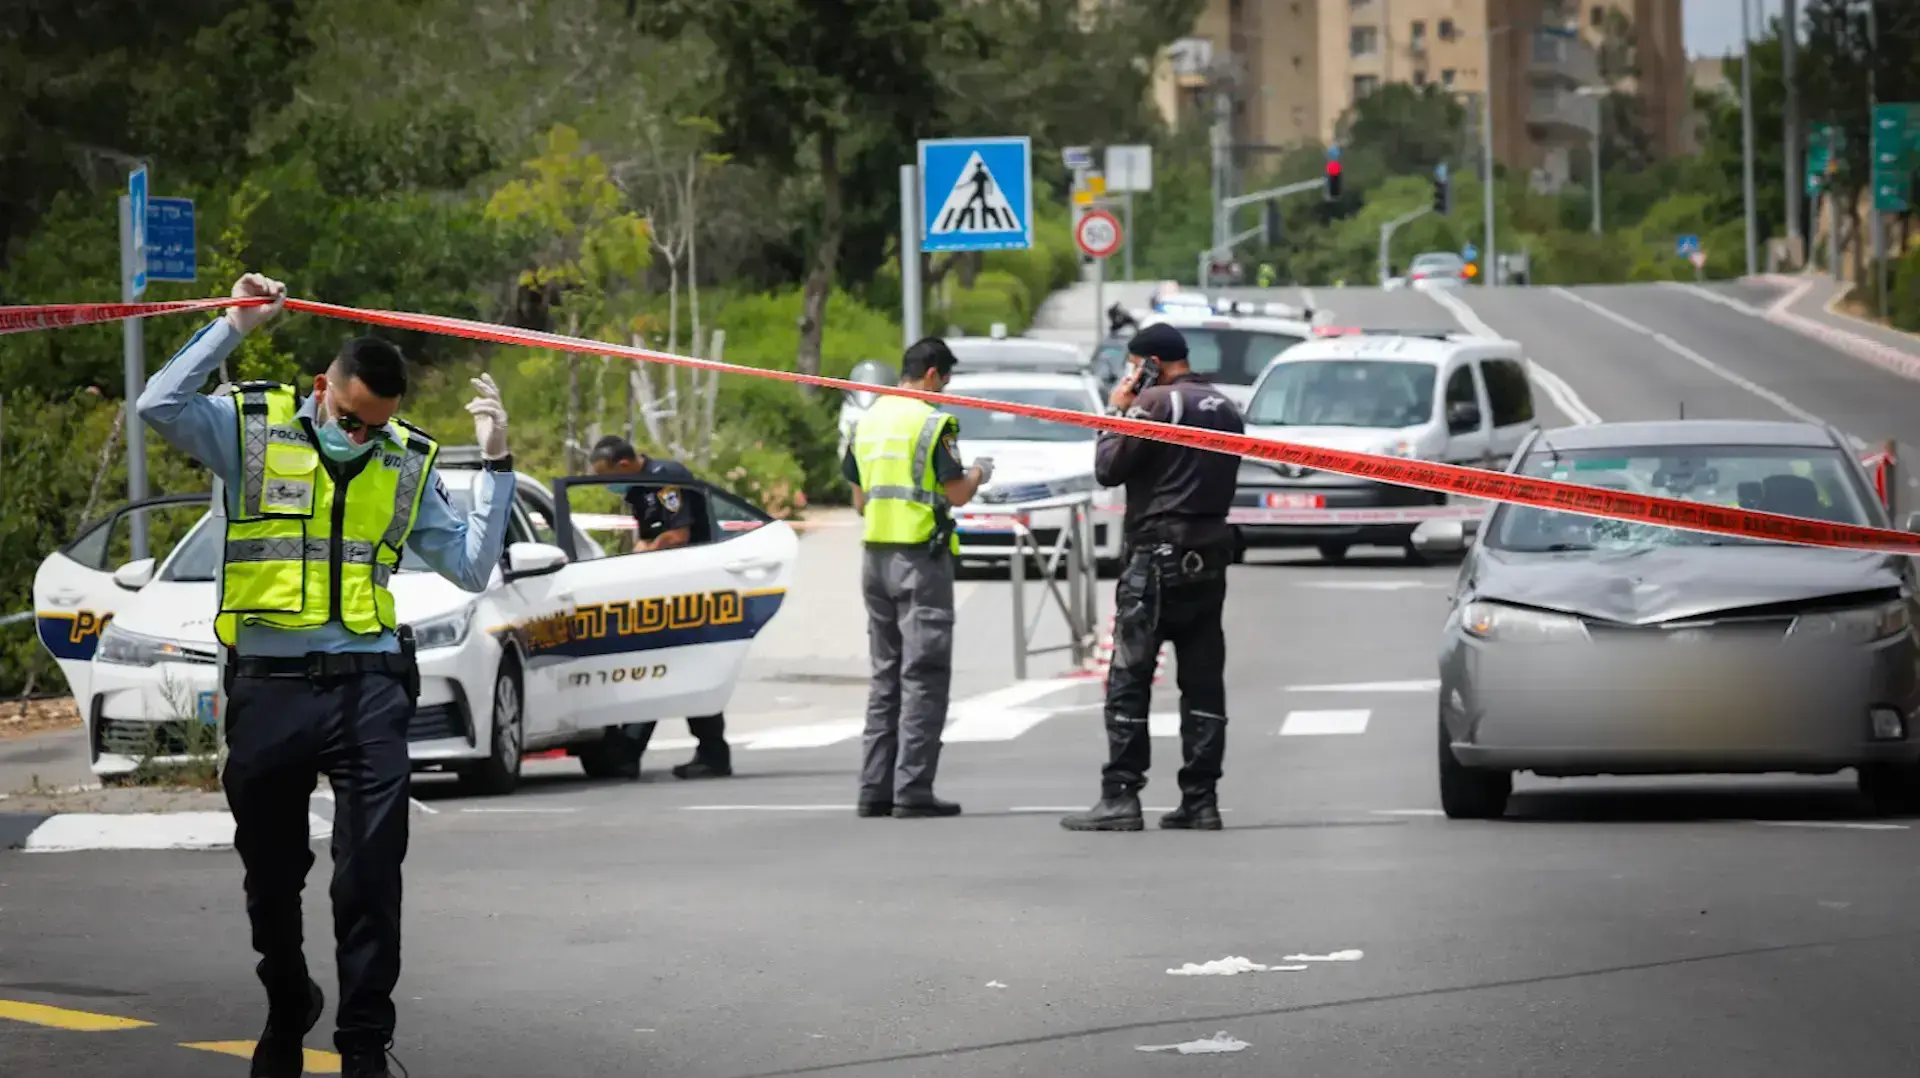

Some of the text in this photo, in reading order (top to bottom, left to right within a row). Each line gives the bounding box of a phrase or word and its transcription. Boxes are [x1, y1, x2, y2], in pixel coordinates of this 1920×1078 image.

[269, 429, 311, 442] POLIC
[574, 590, 744, 639] משטרה
[571, 664, 667, 687] משטרת
